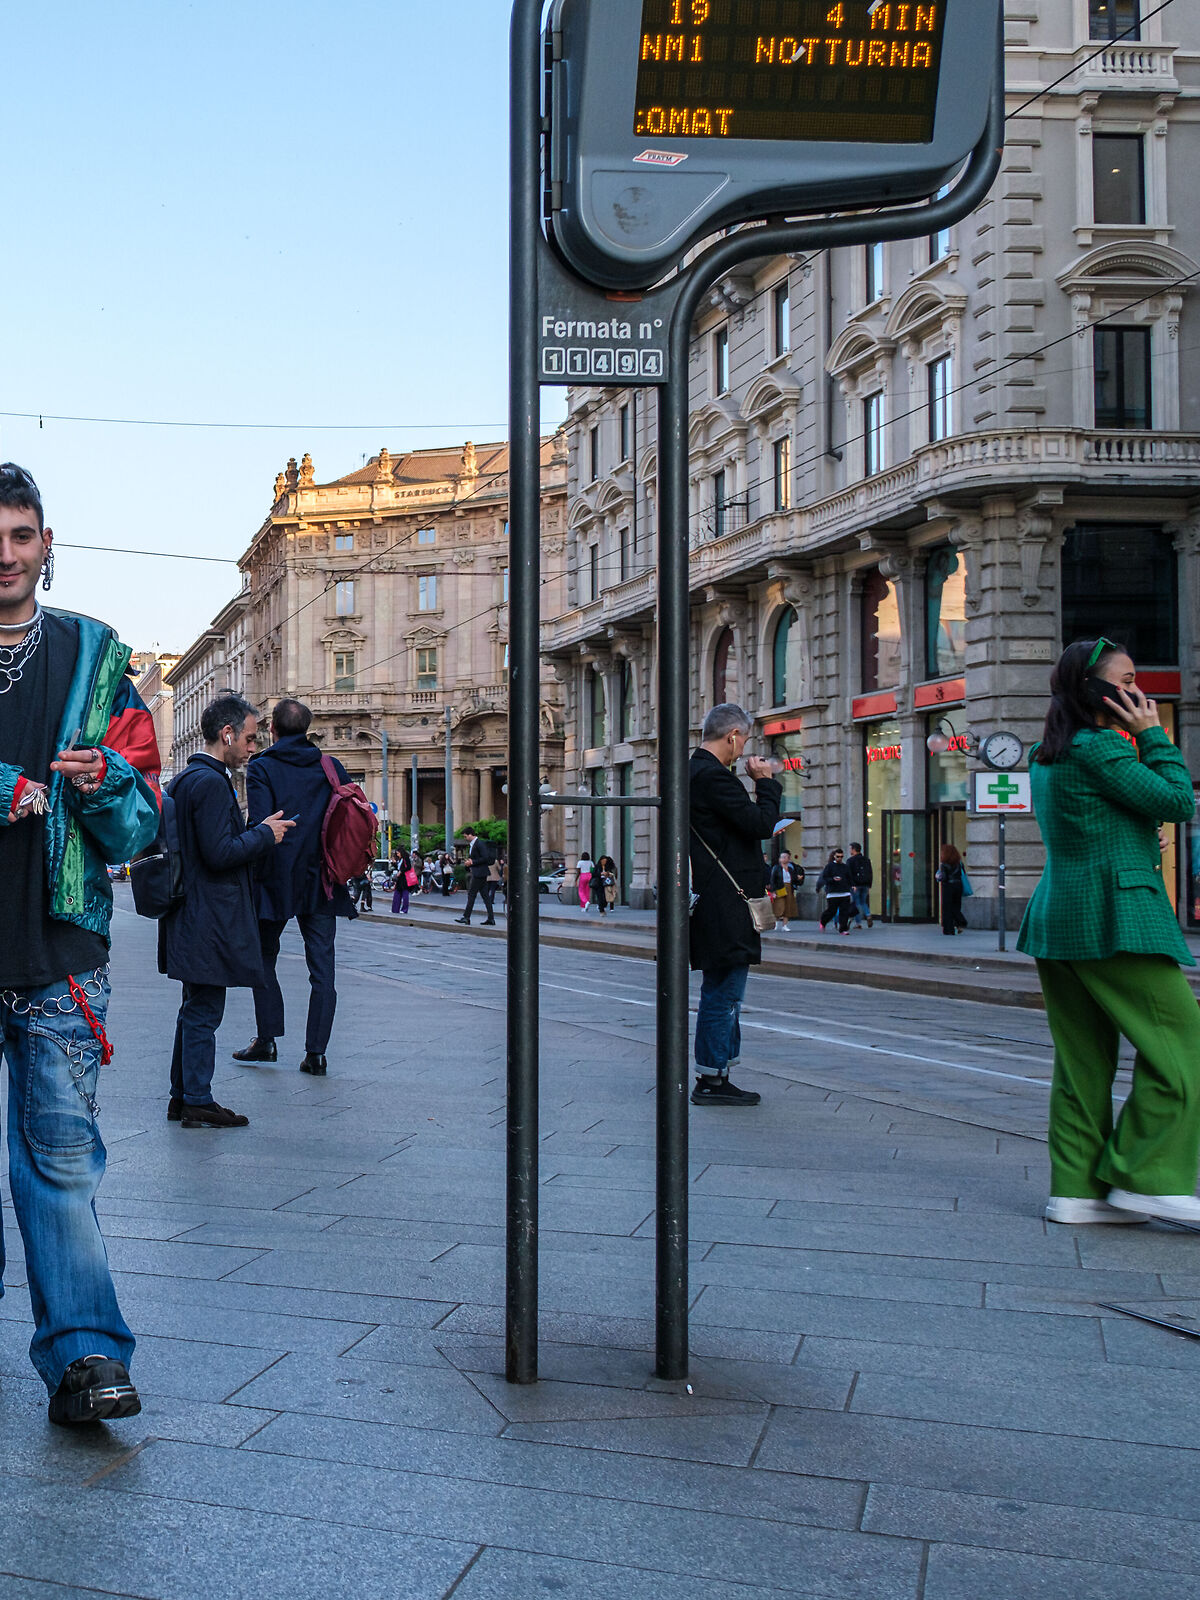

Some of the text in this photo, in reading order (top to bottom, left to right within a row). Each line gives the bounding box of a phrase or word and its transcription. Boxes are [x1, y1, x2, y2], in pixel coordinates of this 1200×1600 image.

[670, 0, 936, 31] 19 4 MIN
[641, 34, 932, 68] NM1 NOTTURNA
[542, 316, 663, 339] Fermata n°
[547, 351, 660, 374] 11494
